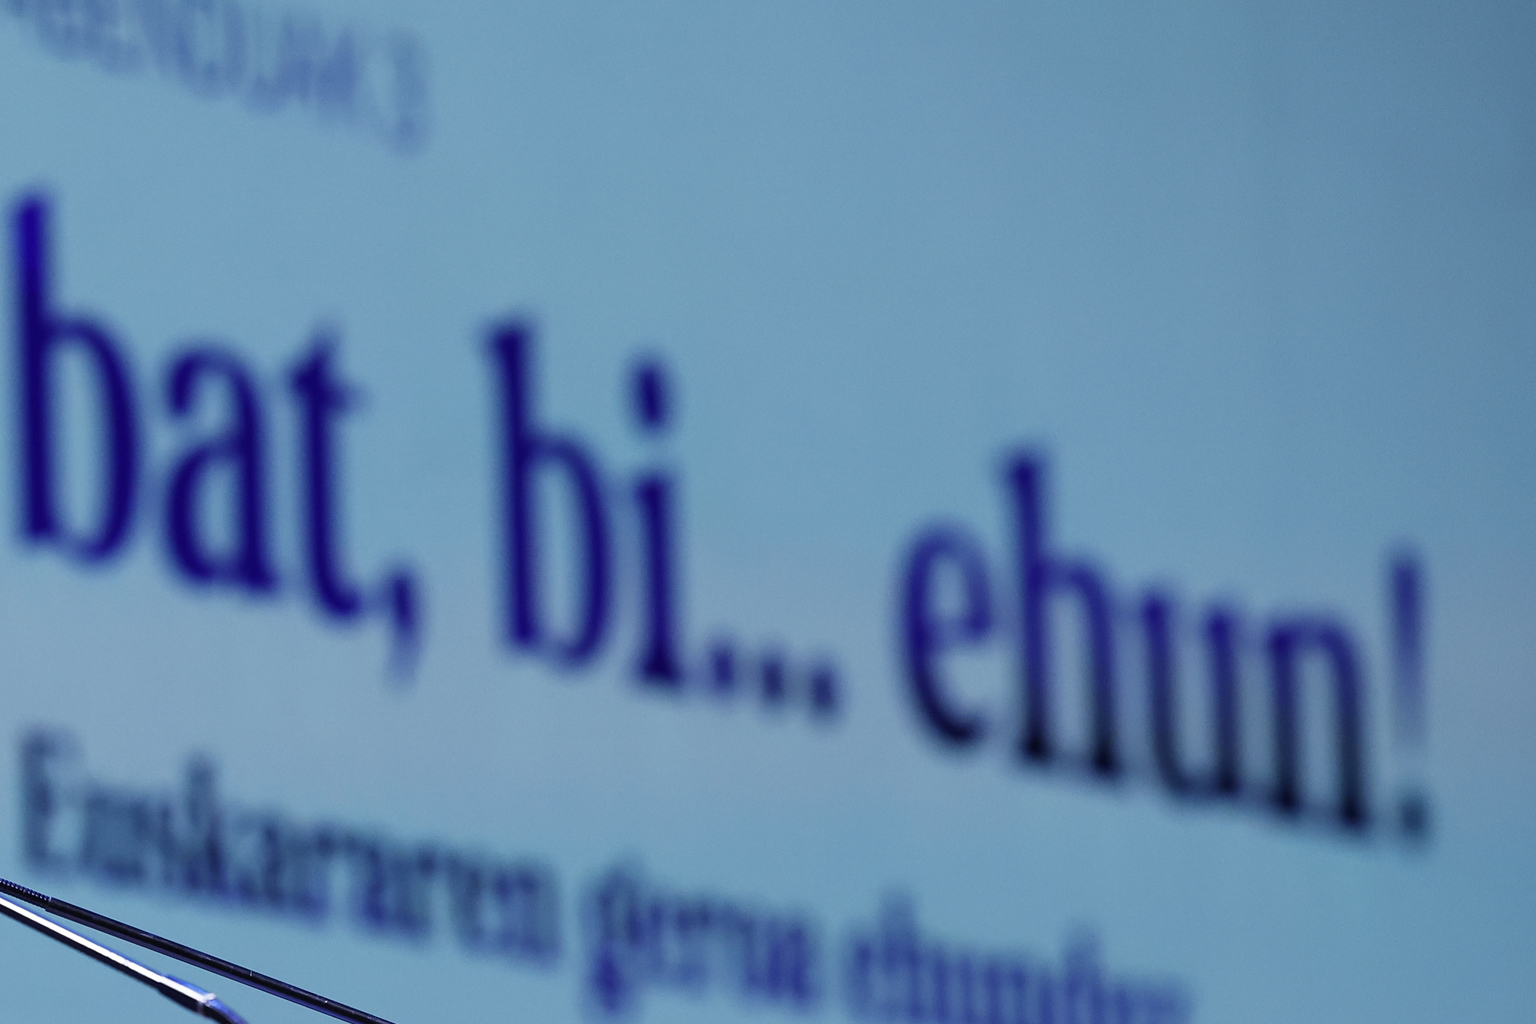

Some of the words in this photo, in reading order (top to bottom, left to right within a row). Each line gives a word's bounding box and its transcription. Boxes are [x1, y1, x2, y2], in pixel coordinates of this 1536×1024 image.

[4, 184, 422, 686] bat,
[479, 308, 844, 733] bi...
[899, 442, 1436, 846] ehun!
[17, 724, 562, 974] Euskararen
